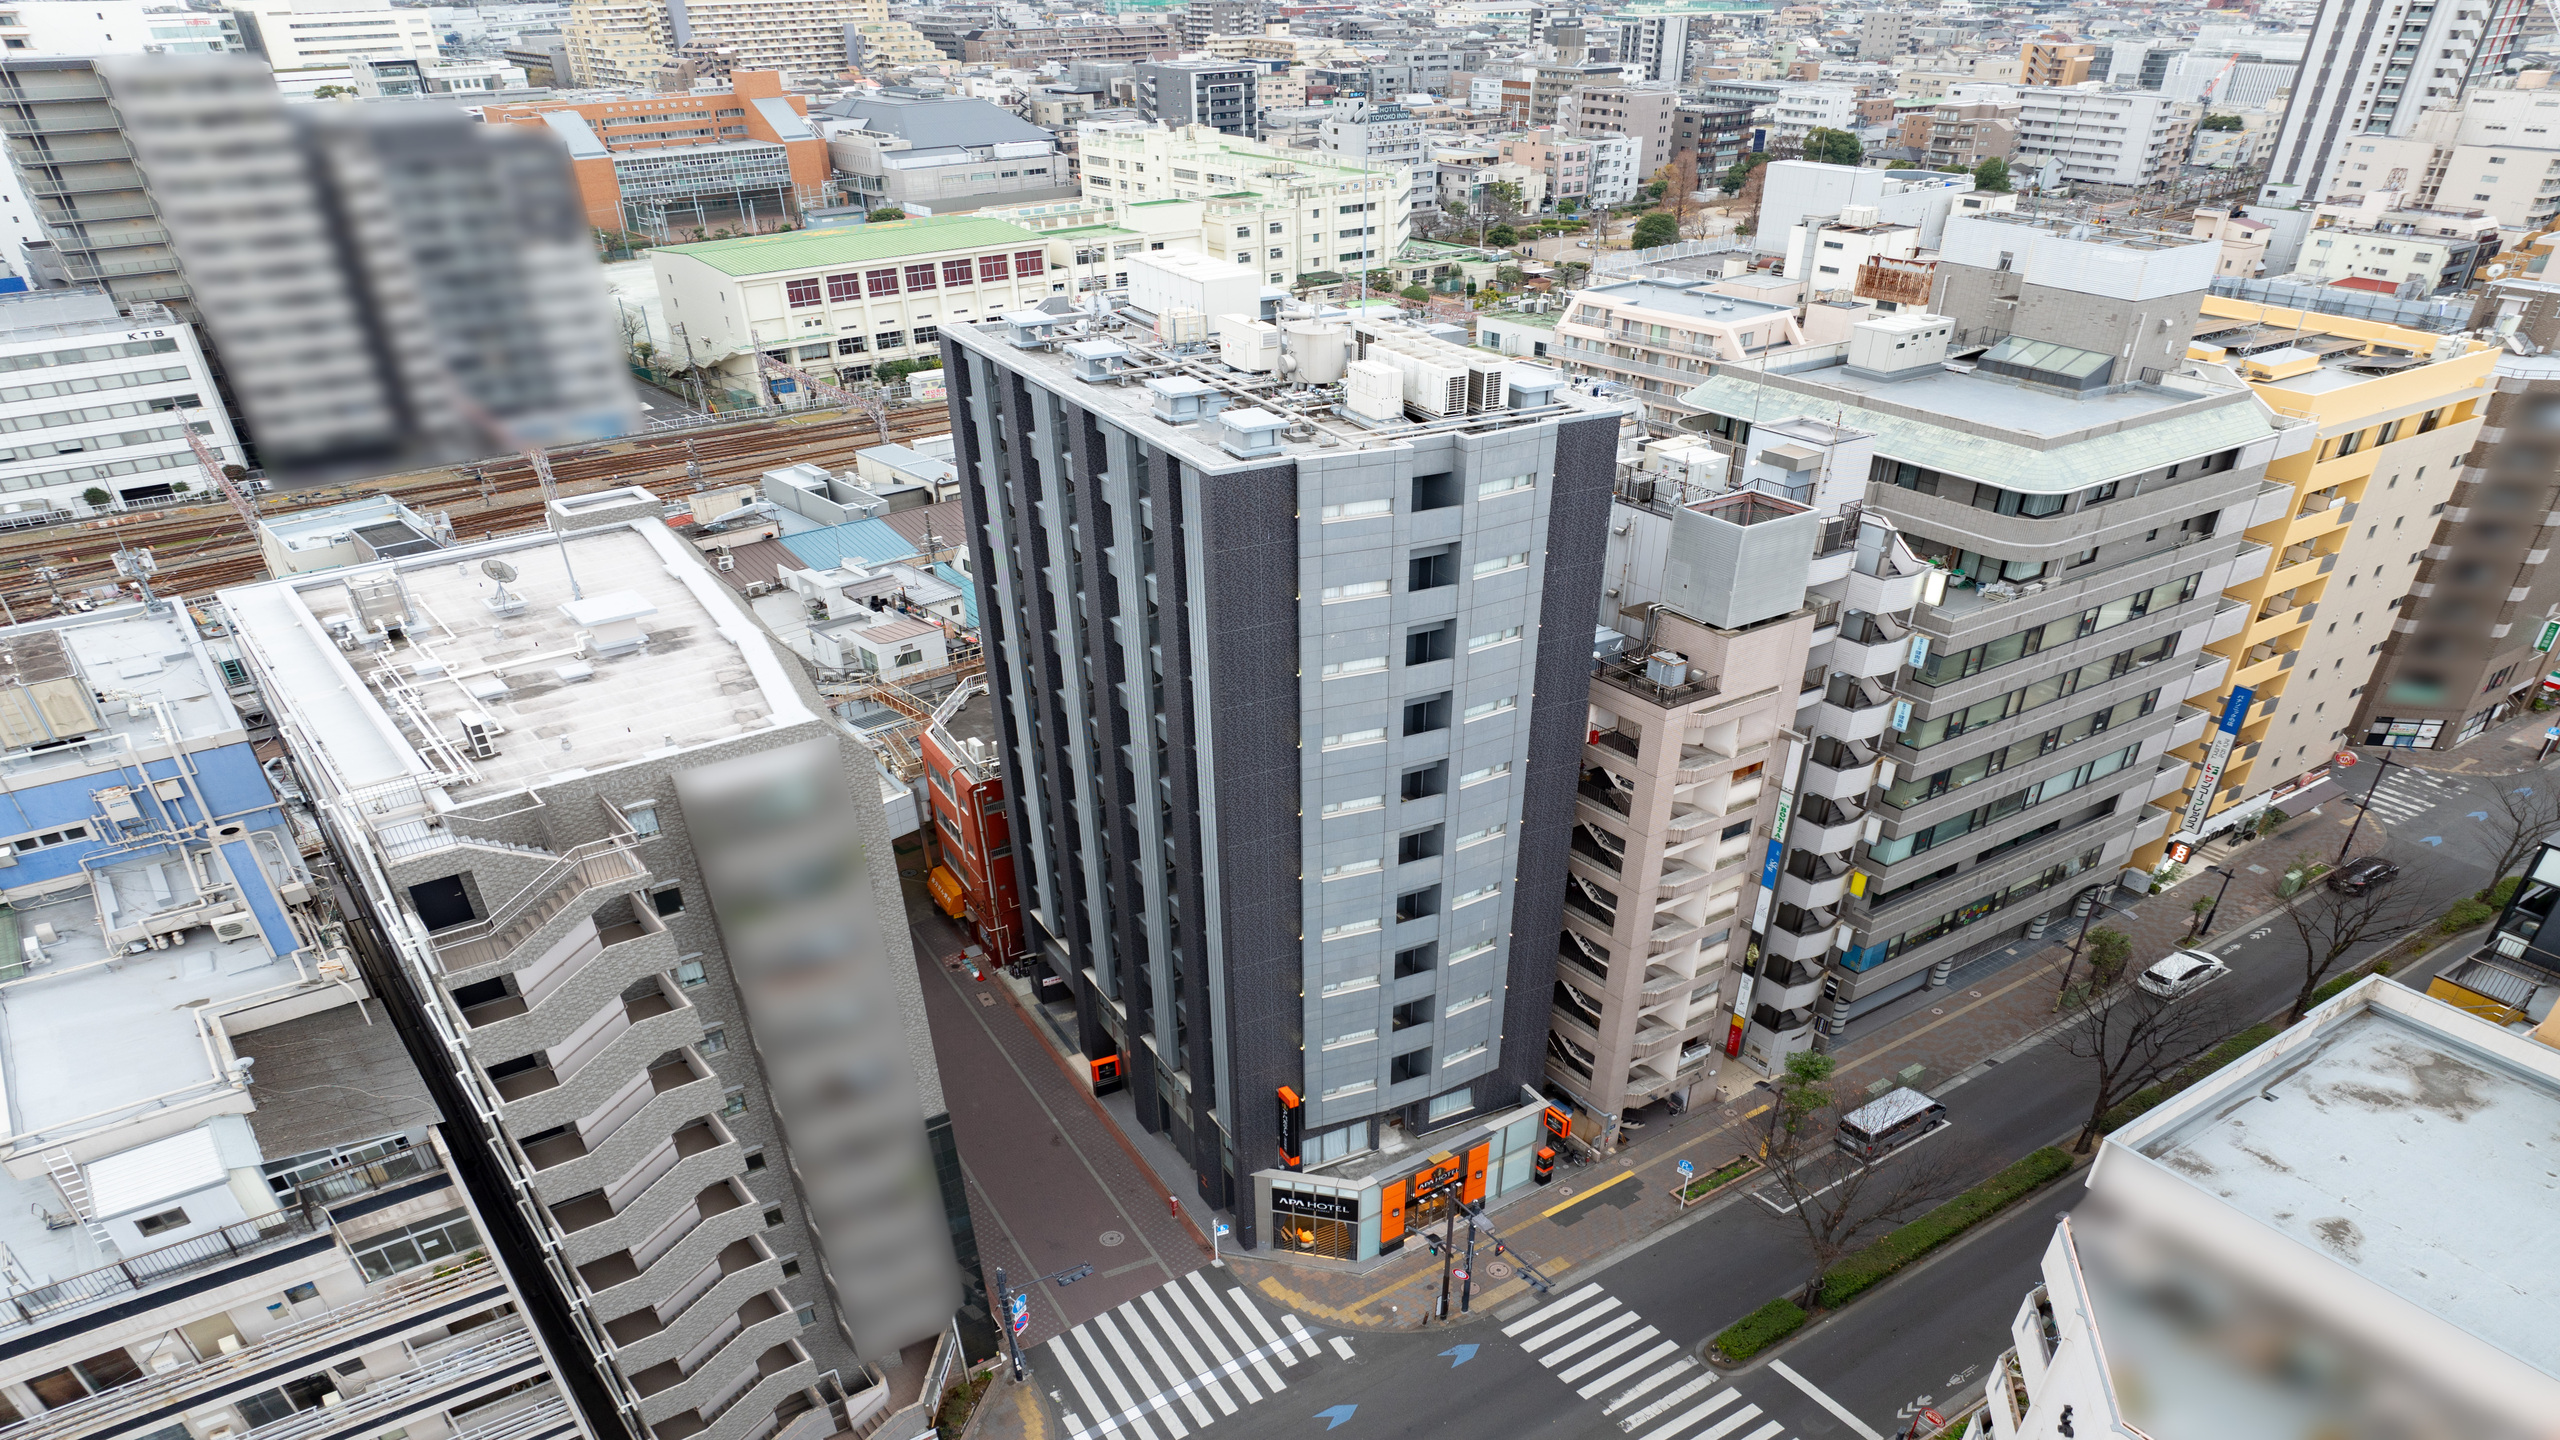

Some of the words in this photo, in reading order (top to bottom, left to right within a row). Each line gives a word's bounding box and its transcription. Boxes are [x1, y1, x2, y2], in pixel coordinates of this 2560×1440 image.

[1379, 105, 1400, 113] HOTEL
[1371, 113, 1396, 121] TOYOKO
[127, 330, 165, 340] KTB
[1774, 806, 1786, 839] BONITA
[1418, 1179, 1434, 1190] APA
[1435, 1168, 1459, 1182] HOTEL
[1279, 1197, 1305, 1207] APA
[1307, 1201, 1350, 1214] HOTEL
